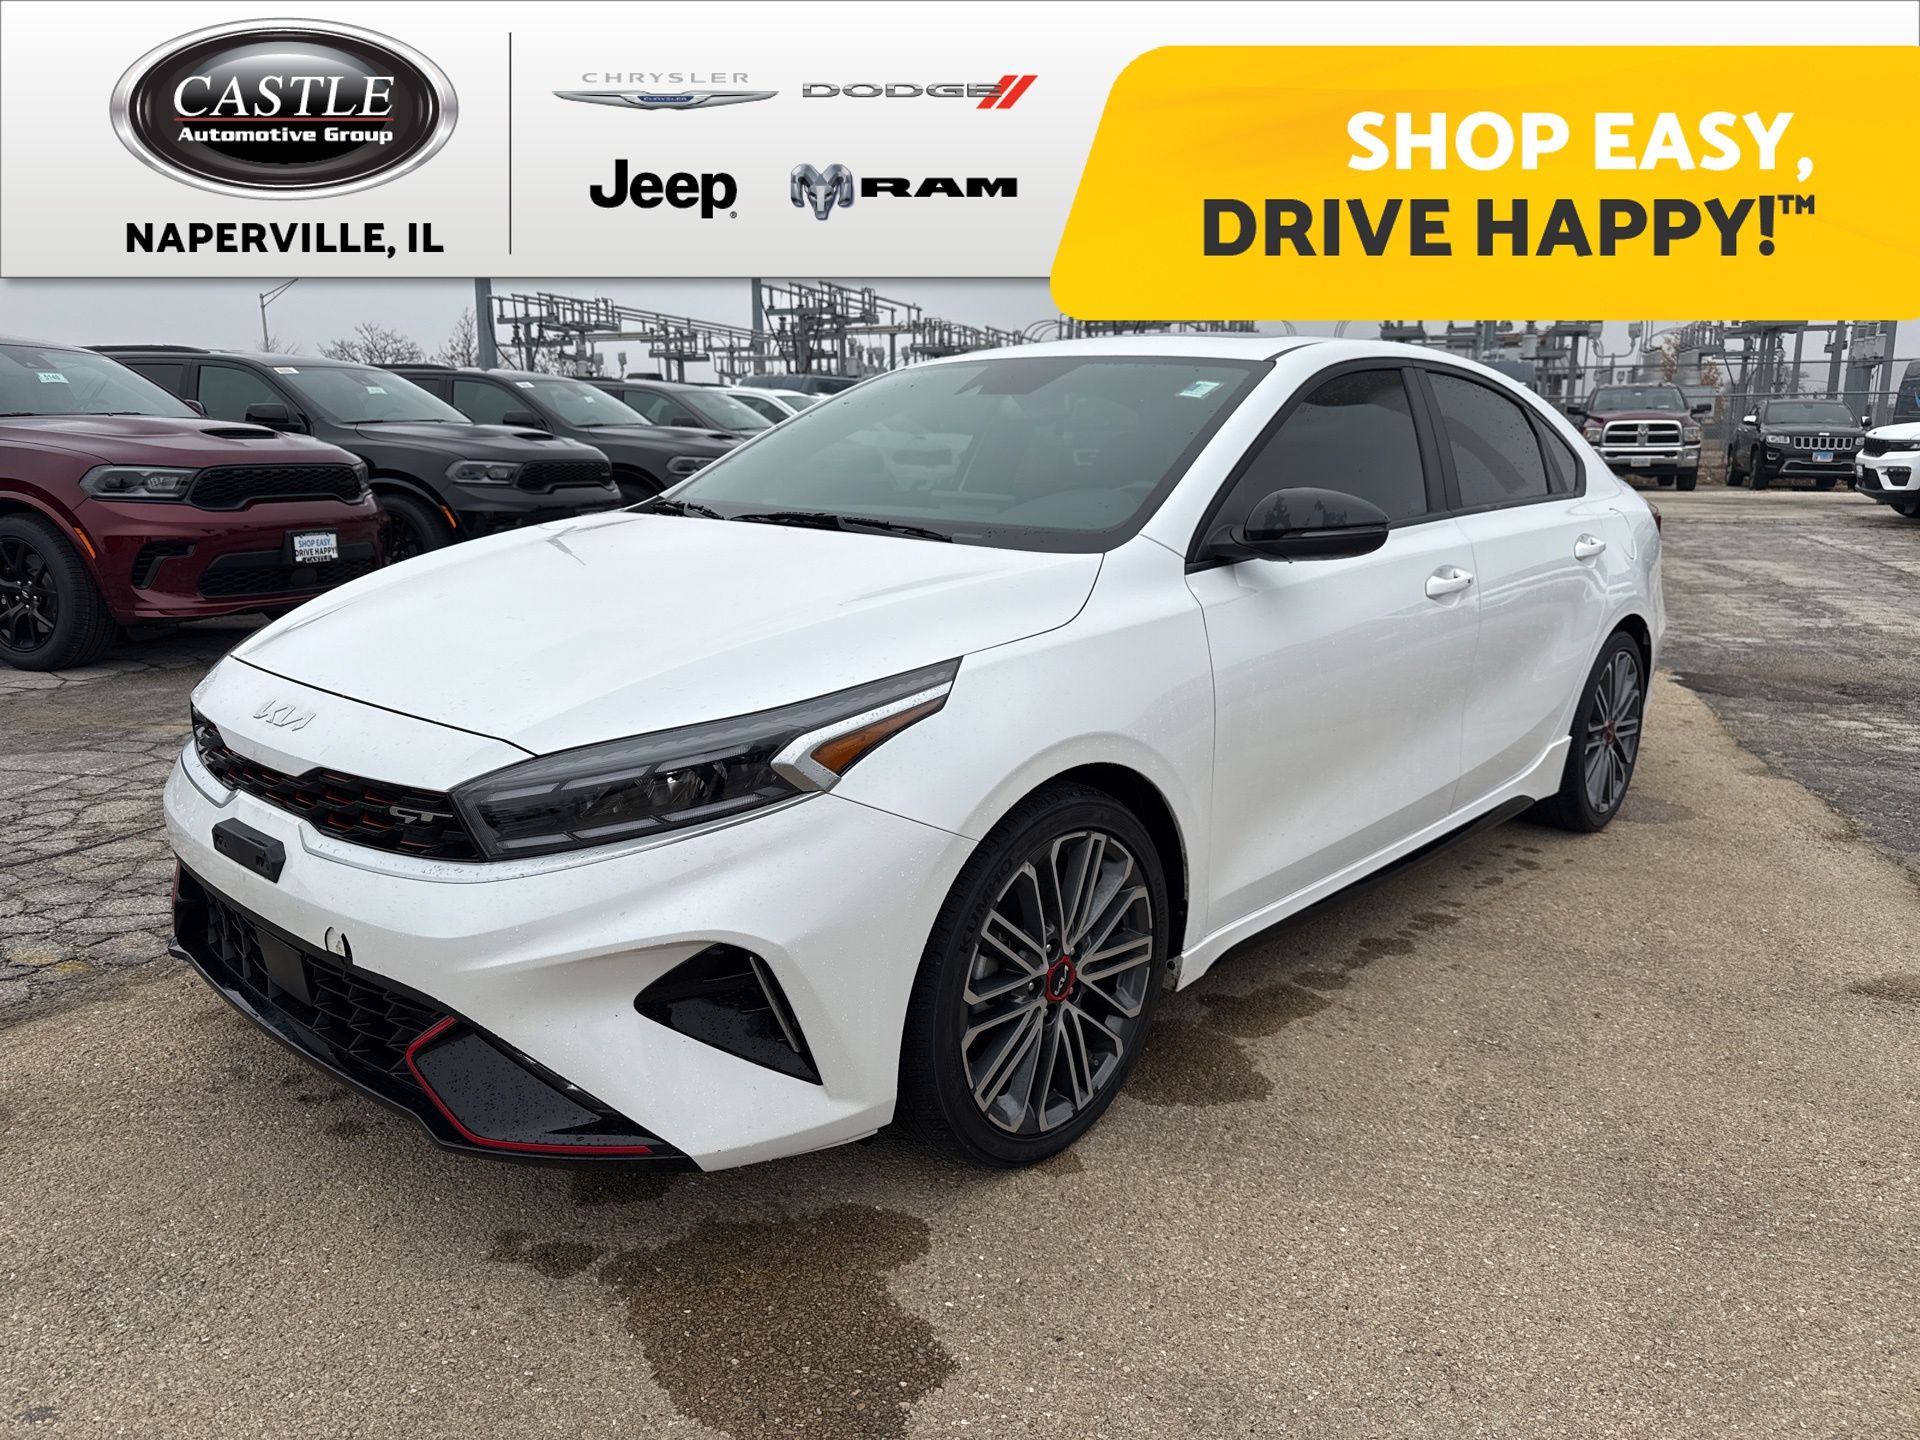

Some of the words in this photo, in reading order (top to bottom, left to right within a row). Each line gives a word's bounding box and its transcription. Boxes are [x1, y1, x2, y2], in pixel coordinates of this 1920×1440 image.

[298, 539, 315, 548] SHOP
[295, 548, 314, 557] DRIVE
[305, 555, 331, 563] CASTLE
